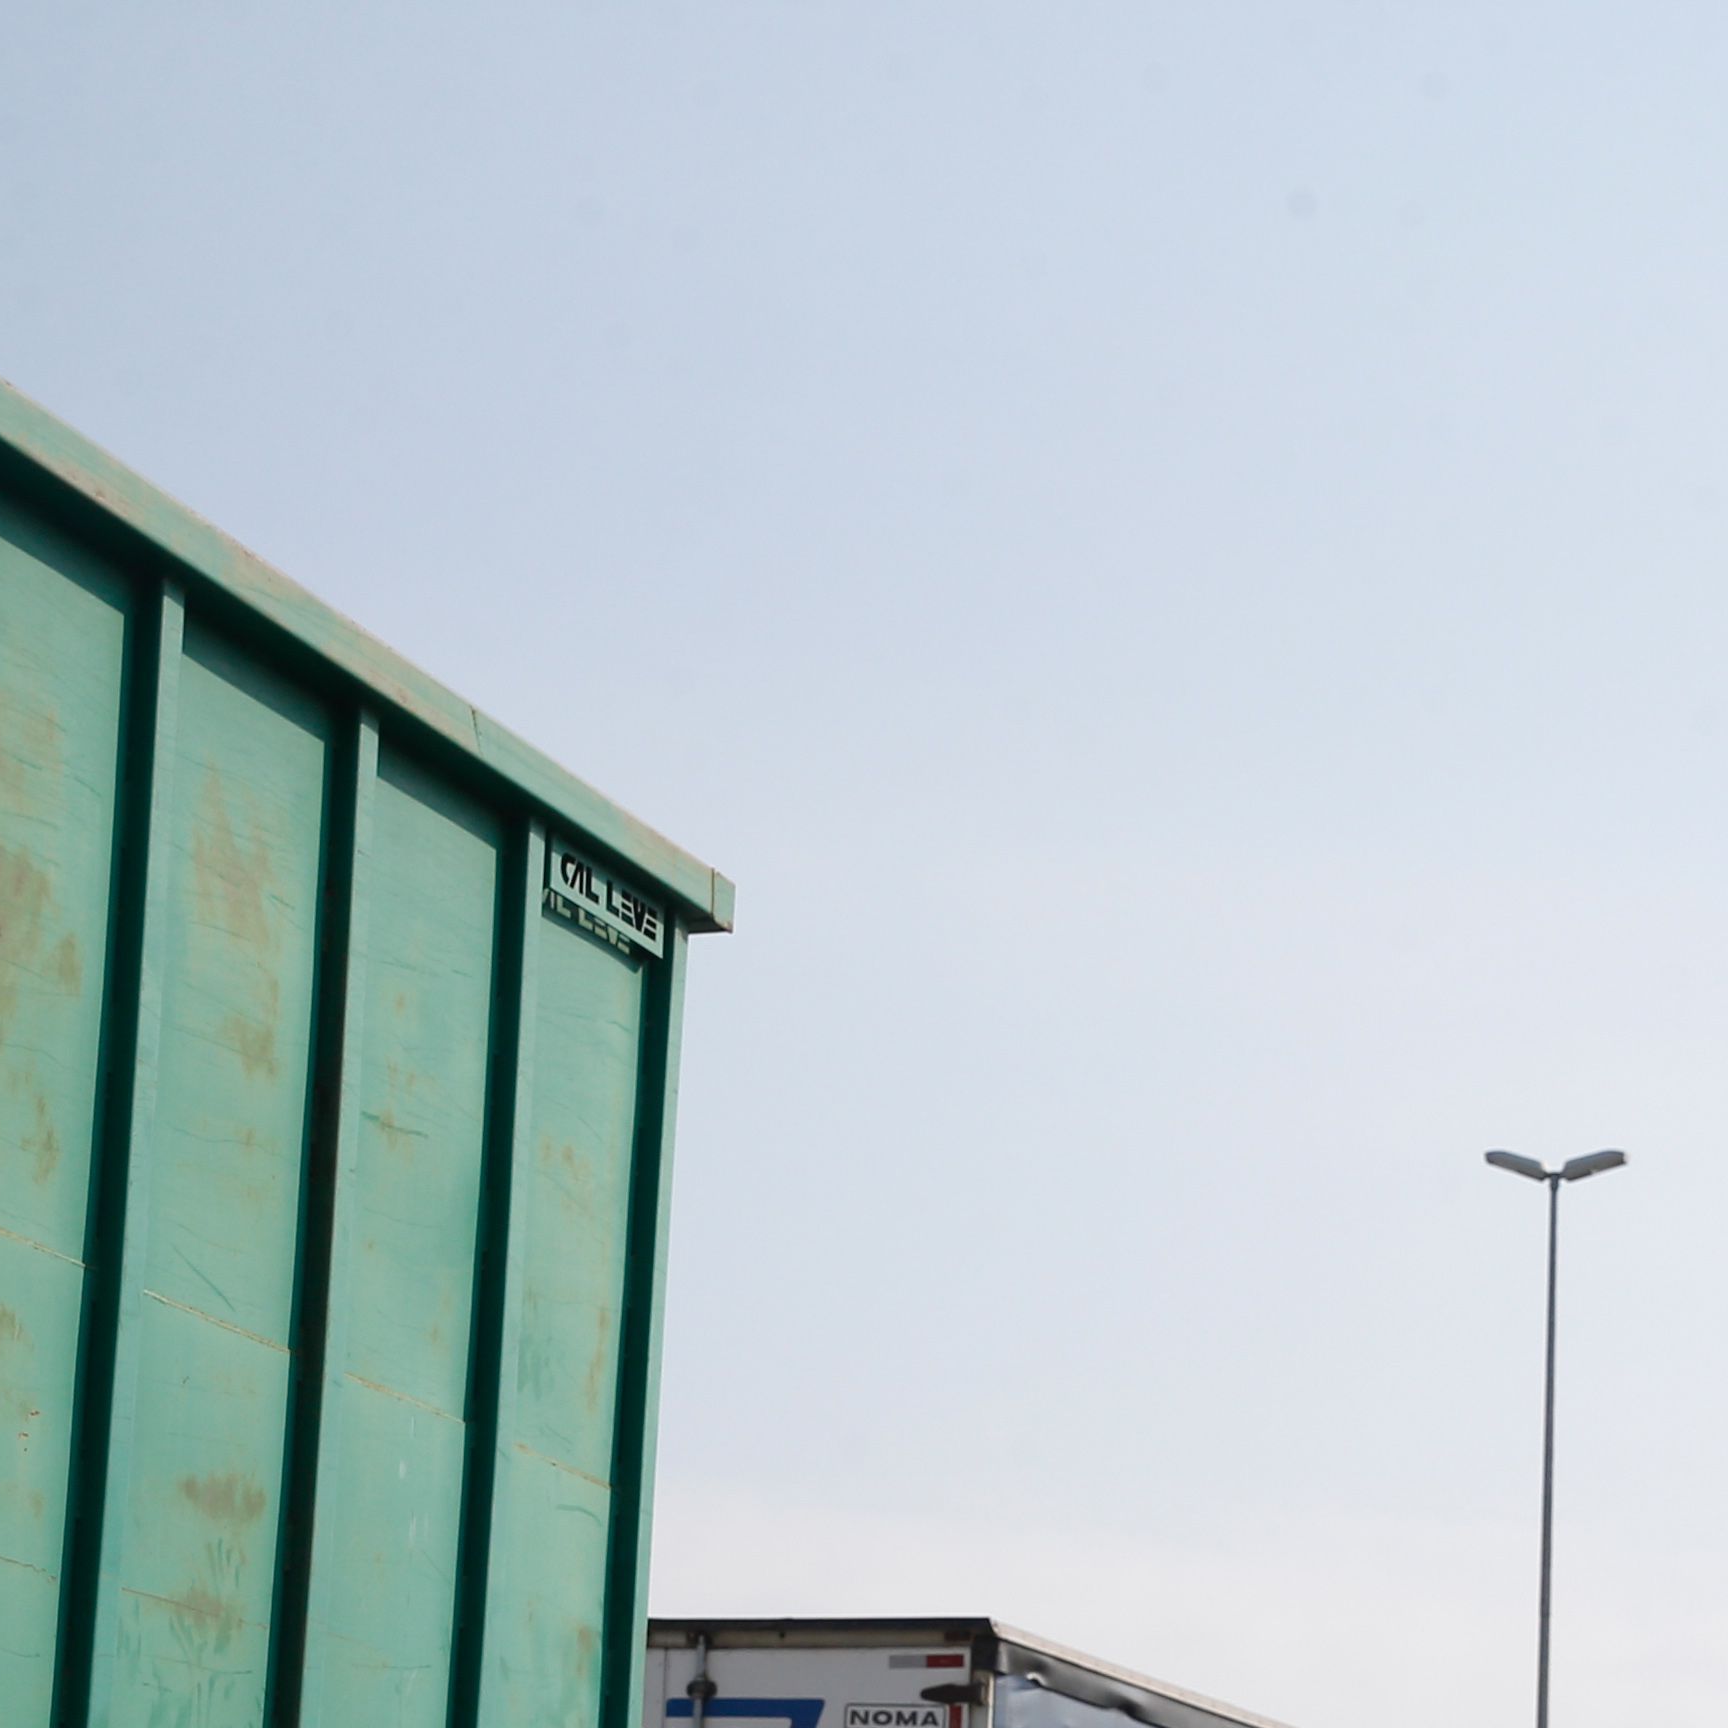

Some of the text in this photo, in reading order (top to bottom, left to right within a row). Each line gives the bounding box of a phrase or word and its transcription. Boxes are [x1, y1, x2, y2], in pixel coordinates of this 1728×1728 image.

[561, 853, 658, 942] CAL LEVE
[848, 1708, 940, 1728] NOMA
